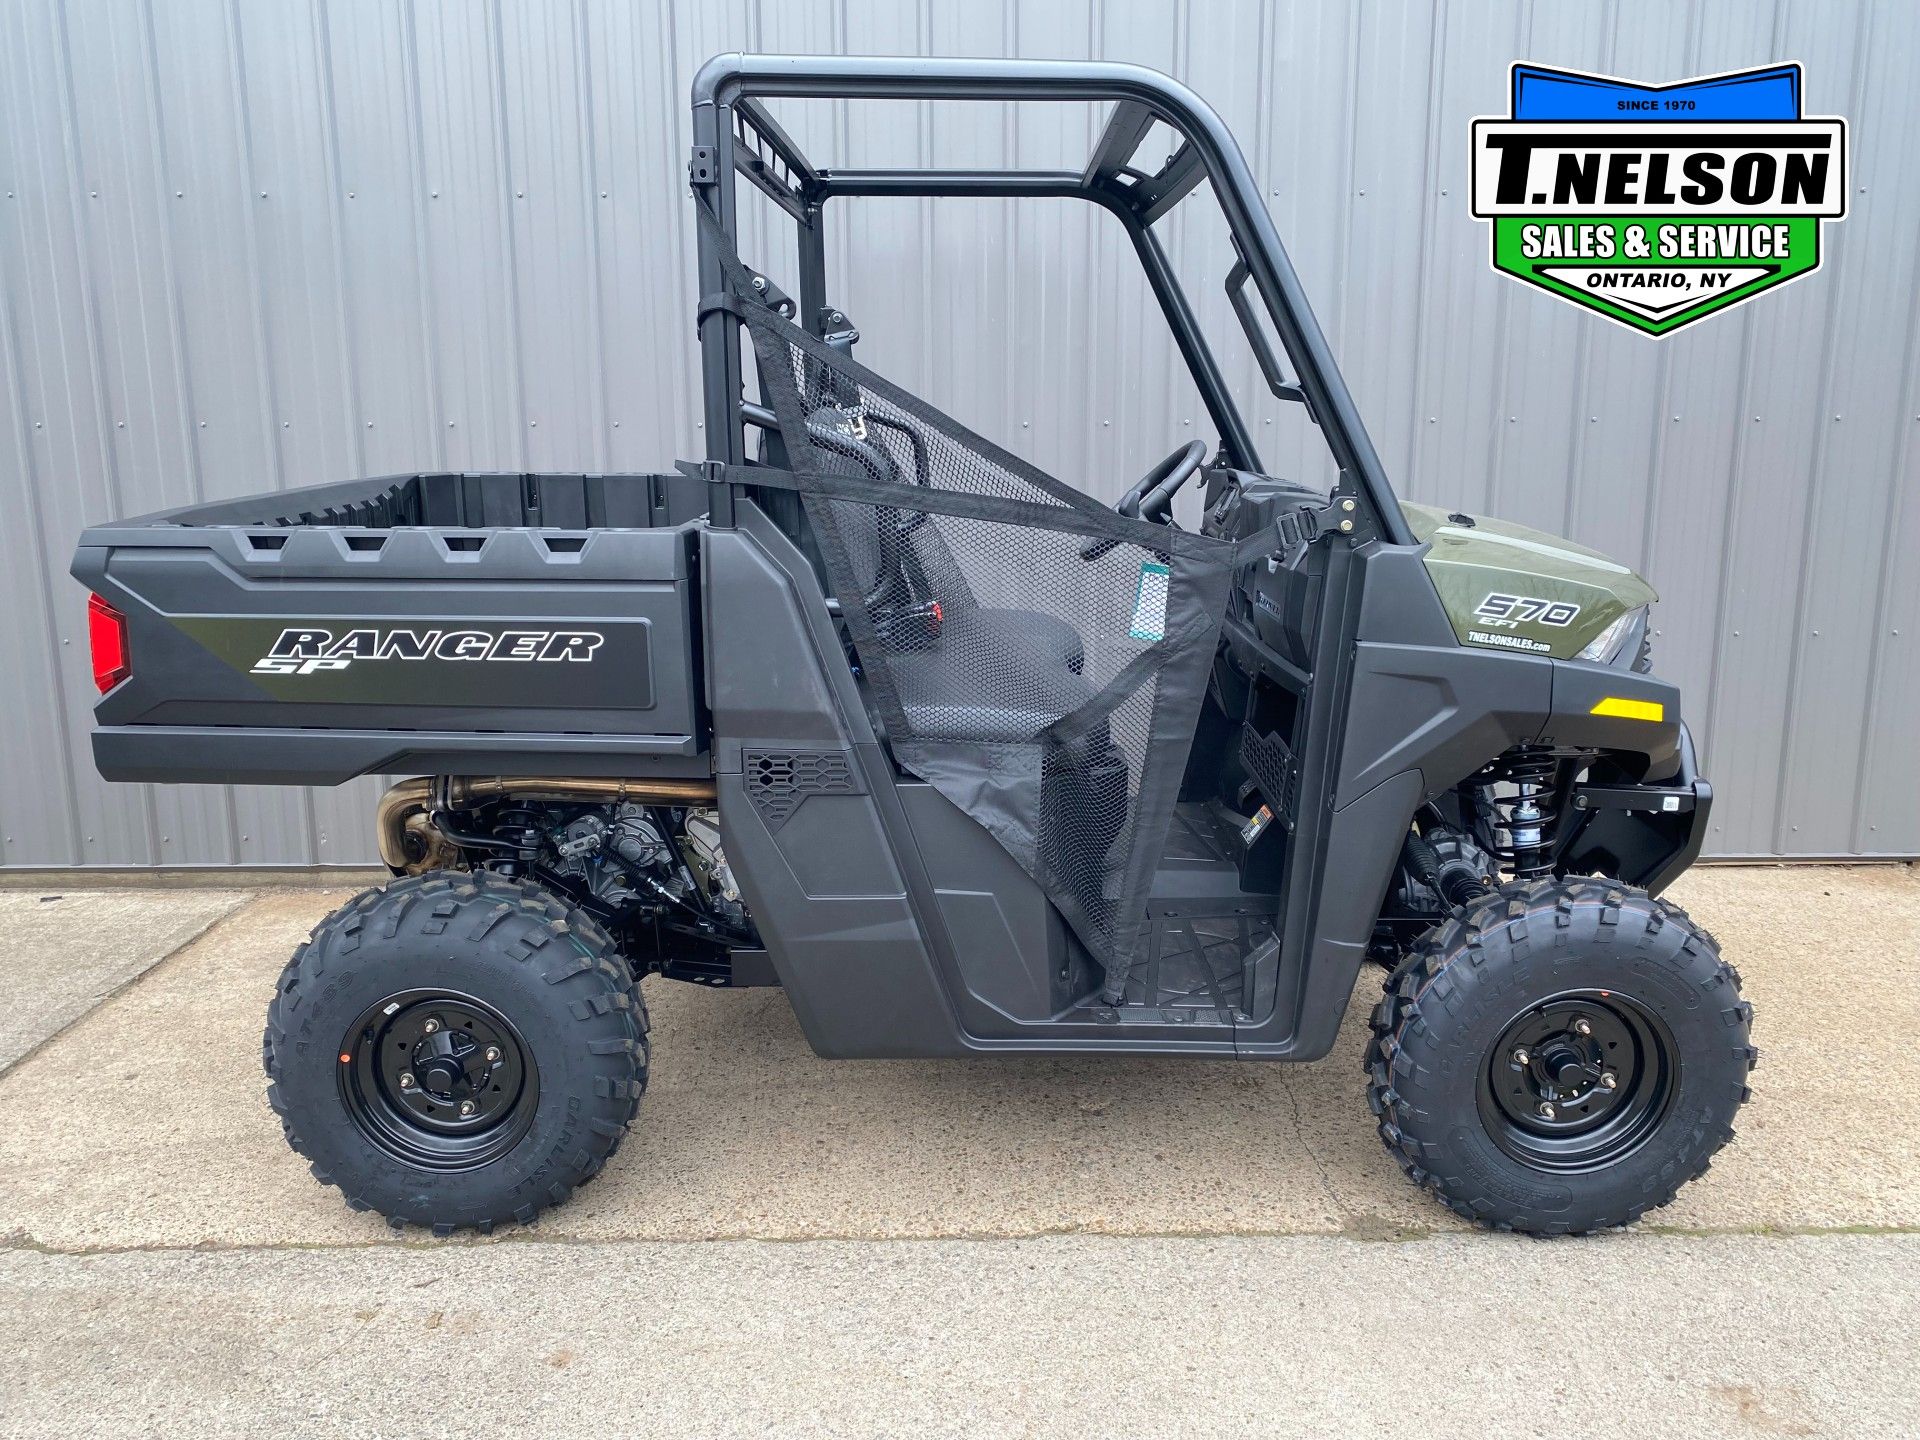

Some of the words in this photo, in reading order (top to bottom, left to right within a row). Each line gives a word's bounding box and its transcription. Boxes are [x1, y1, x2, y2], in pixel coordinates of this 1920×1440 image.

[1473, 592, 1581, 627] 570
[1478, 617, 1519, 629] EFI
[267, 628, 604, 662] RANGER
[1468, 631, 1551, 652] TNELSONSALES.com
[249, 659, 352, 675] SP
